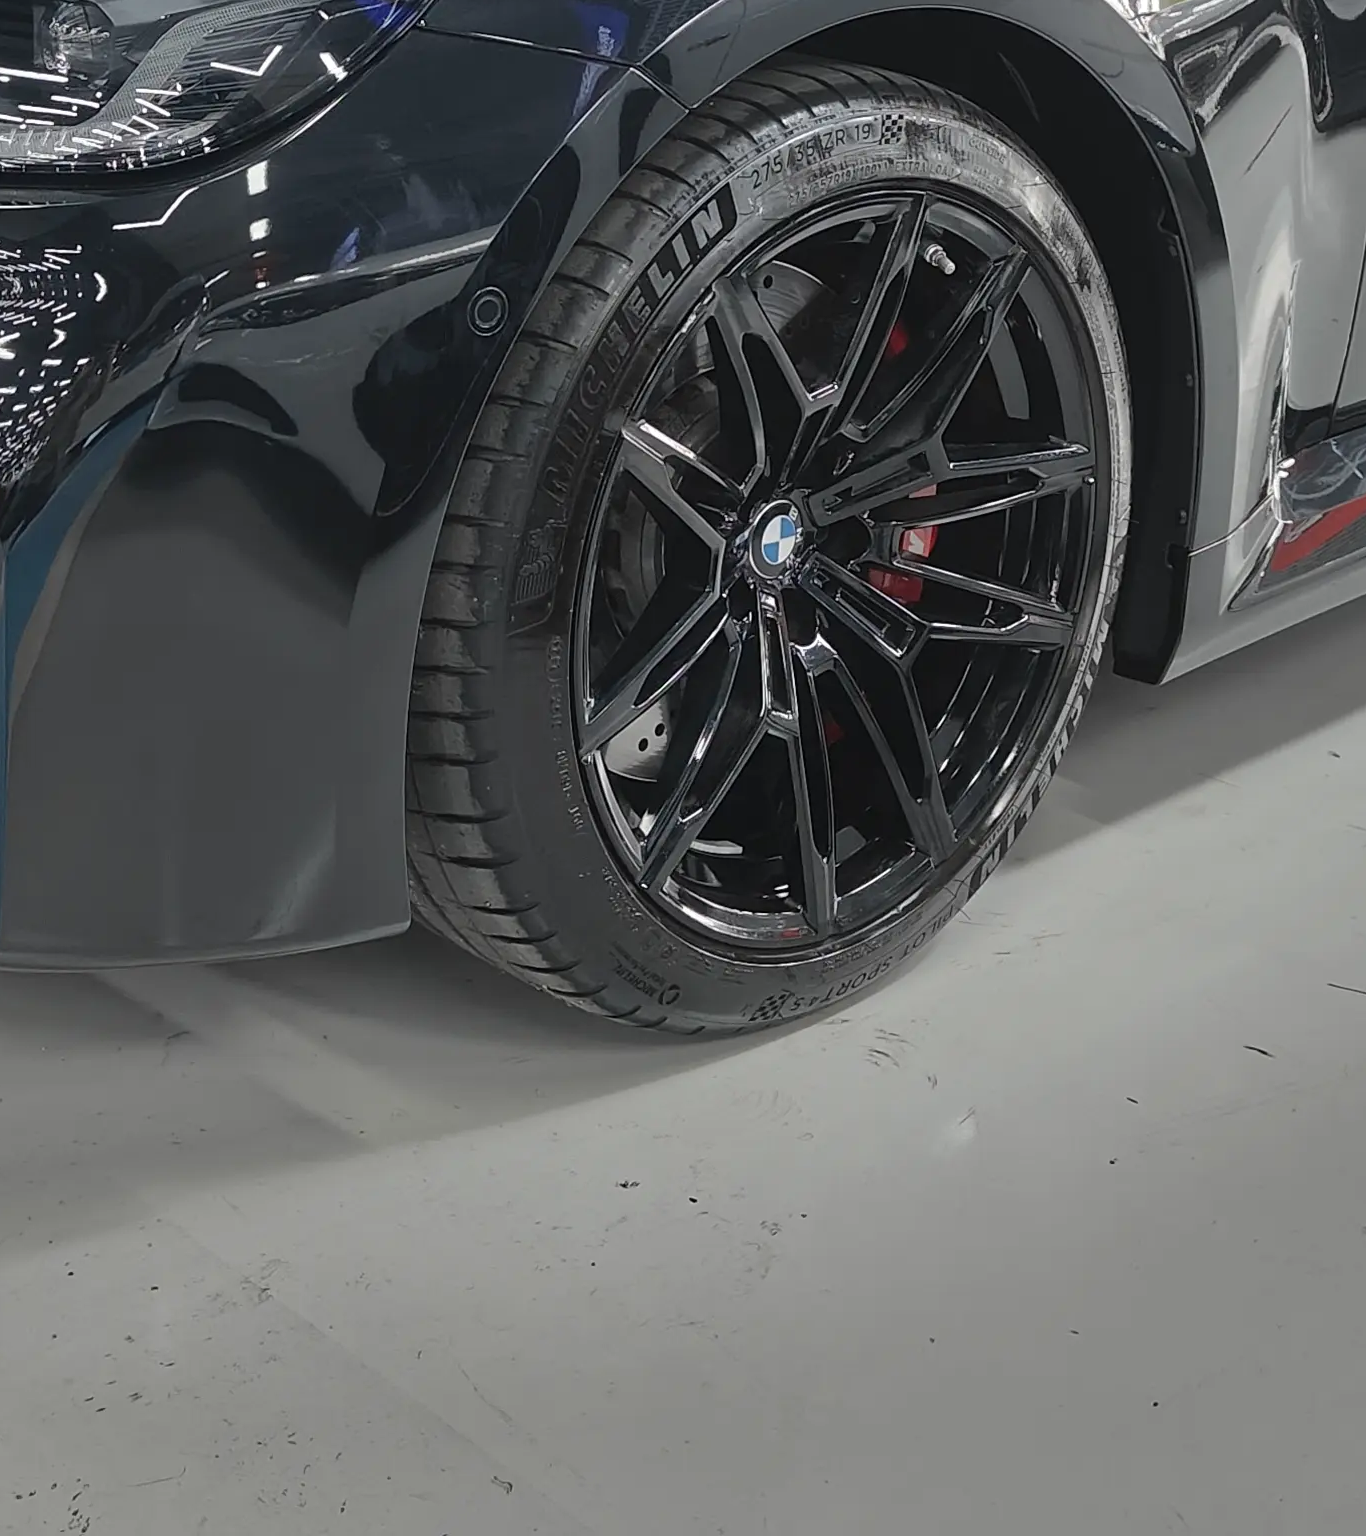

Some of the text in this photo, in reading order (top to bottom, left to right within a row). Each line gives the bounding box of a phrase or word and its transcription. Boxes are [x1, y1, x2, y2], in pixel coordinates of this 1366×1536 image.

[751, 123, 872, 189] 275/35 ZR 19
[540, 198, 723, 503] MICHELIN
[900, 904, 956, 958] PILOT
[820, 955, 894, 1004] SPORT
